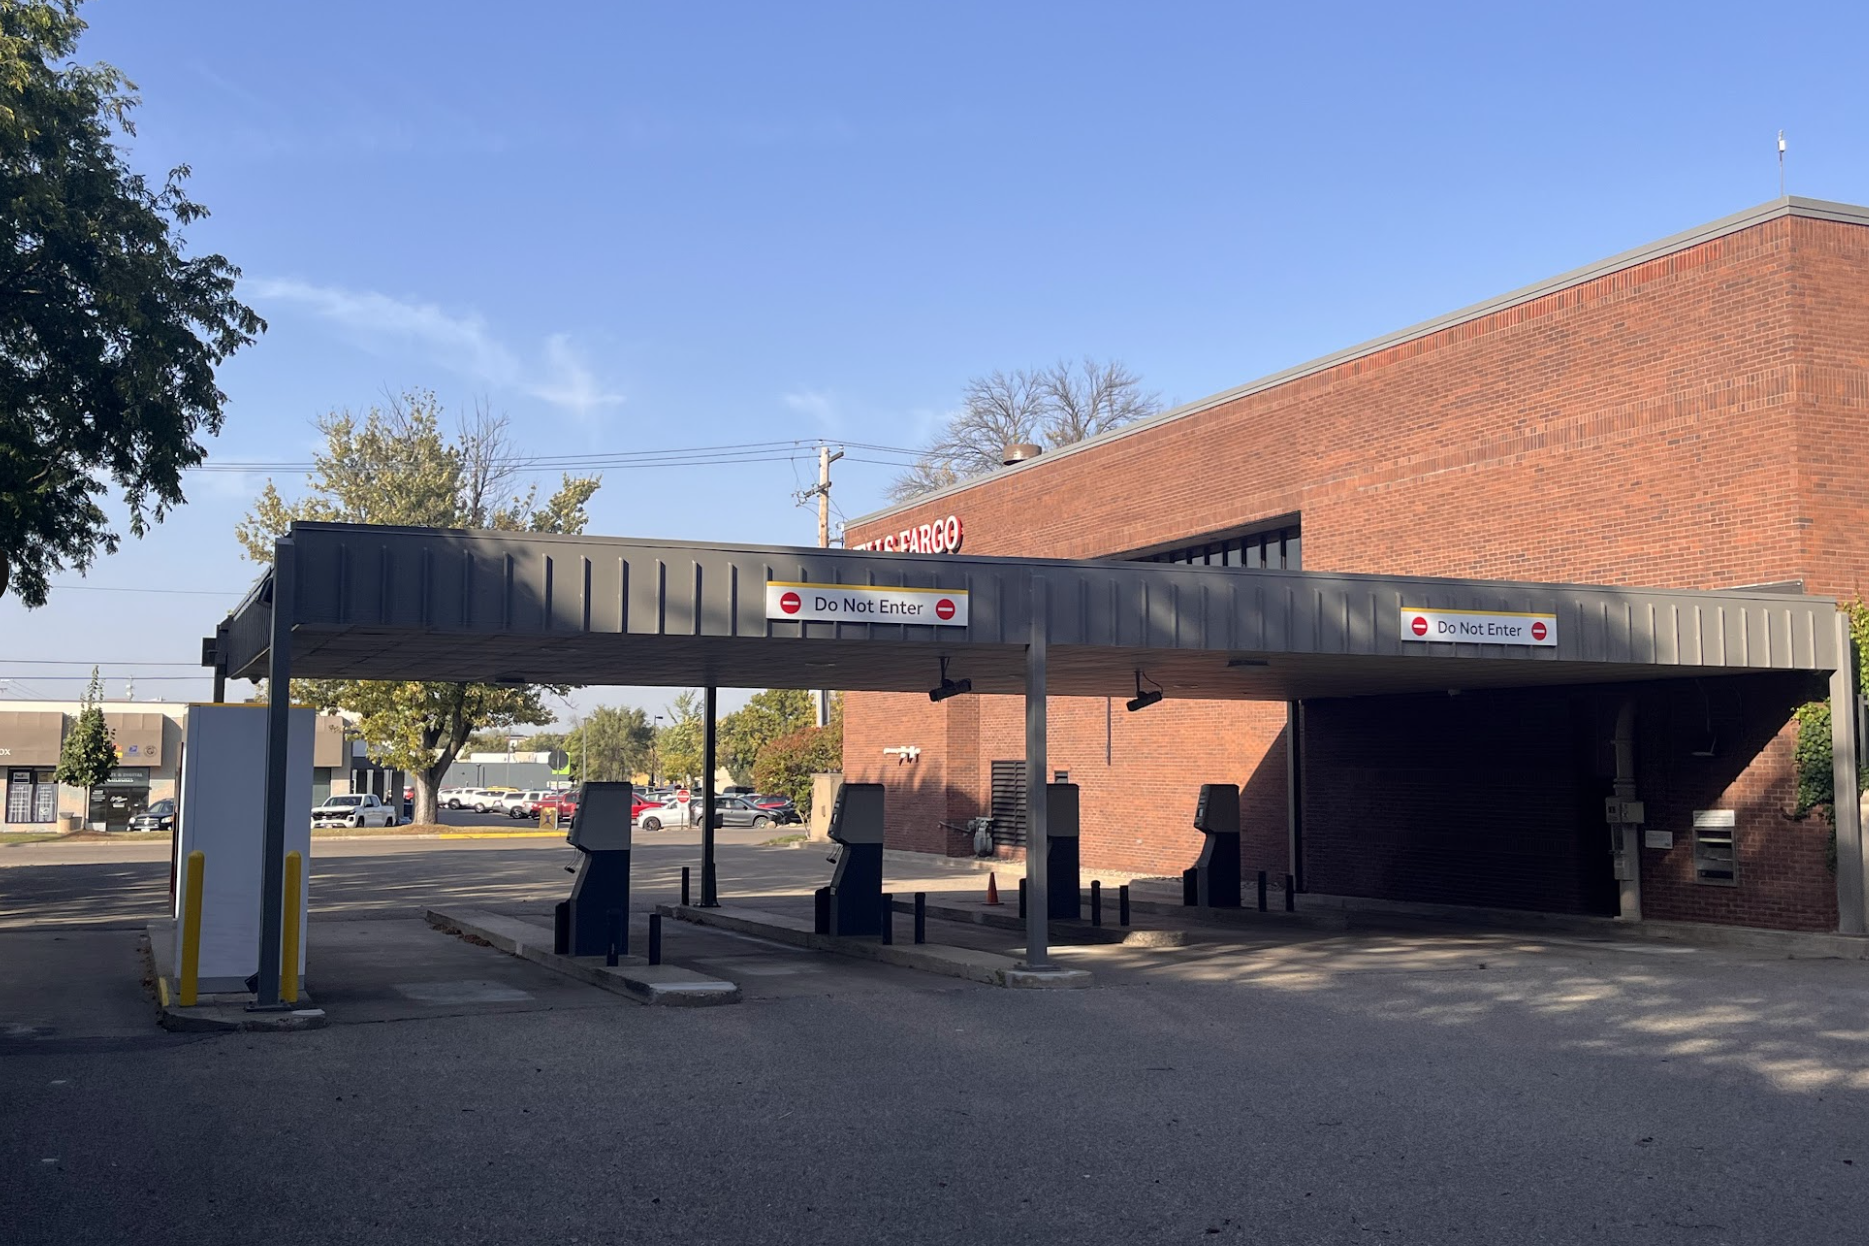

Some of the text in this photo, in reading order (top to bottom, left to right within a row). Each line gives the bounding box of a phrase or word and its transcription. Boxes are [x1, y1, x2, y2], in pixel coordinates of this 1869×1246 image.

[900, 515, 961, 553] FARGO
[815, 596, 924, 615] Do Not Enter
[1437, 620, 1522, 637] Do Not Enter
